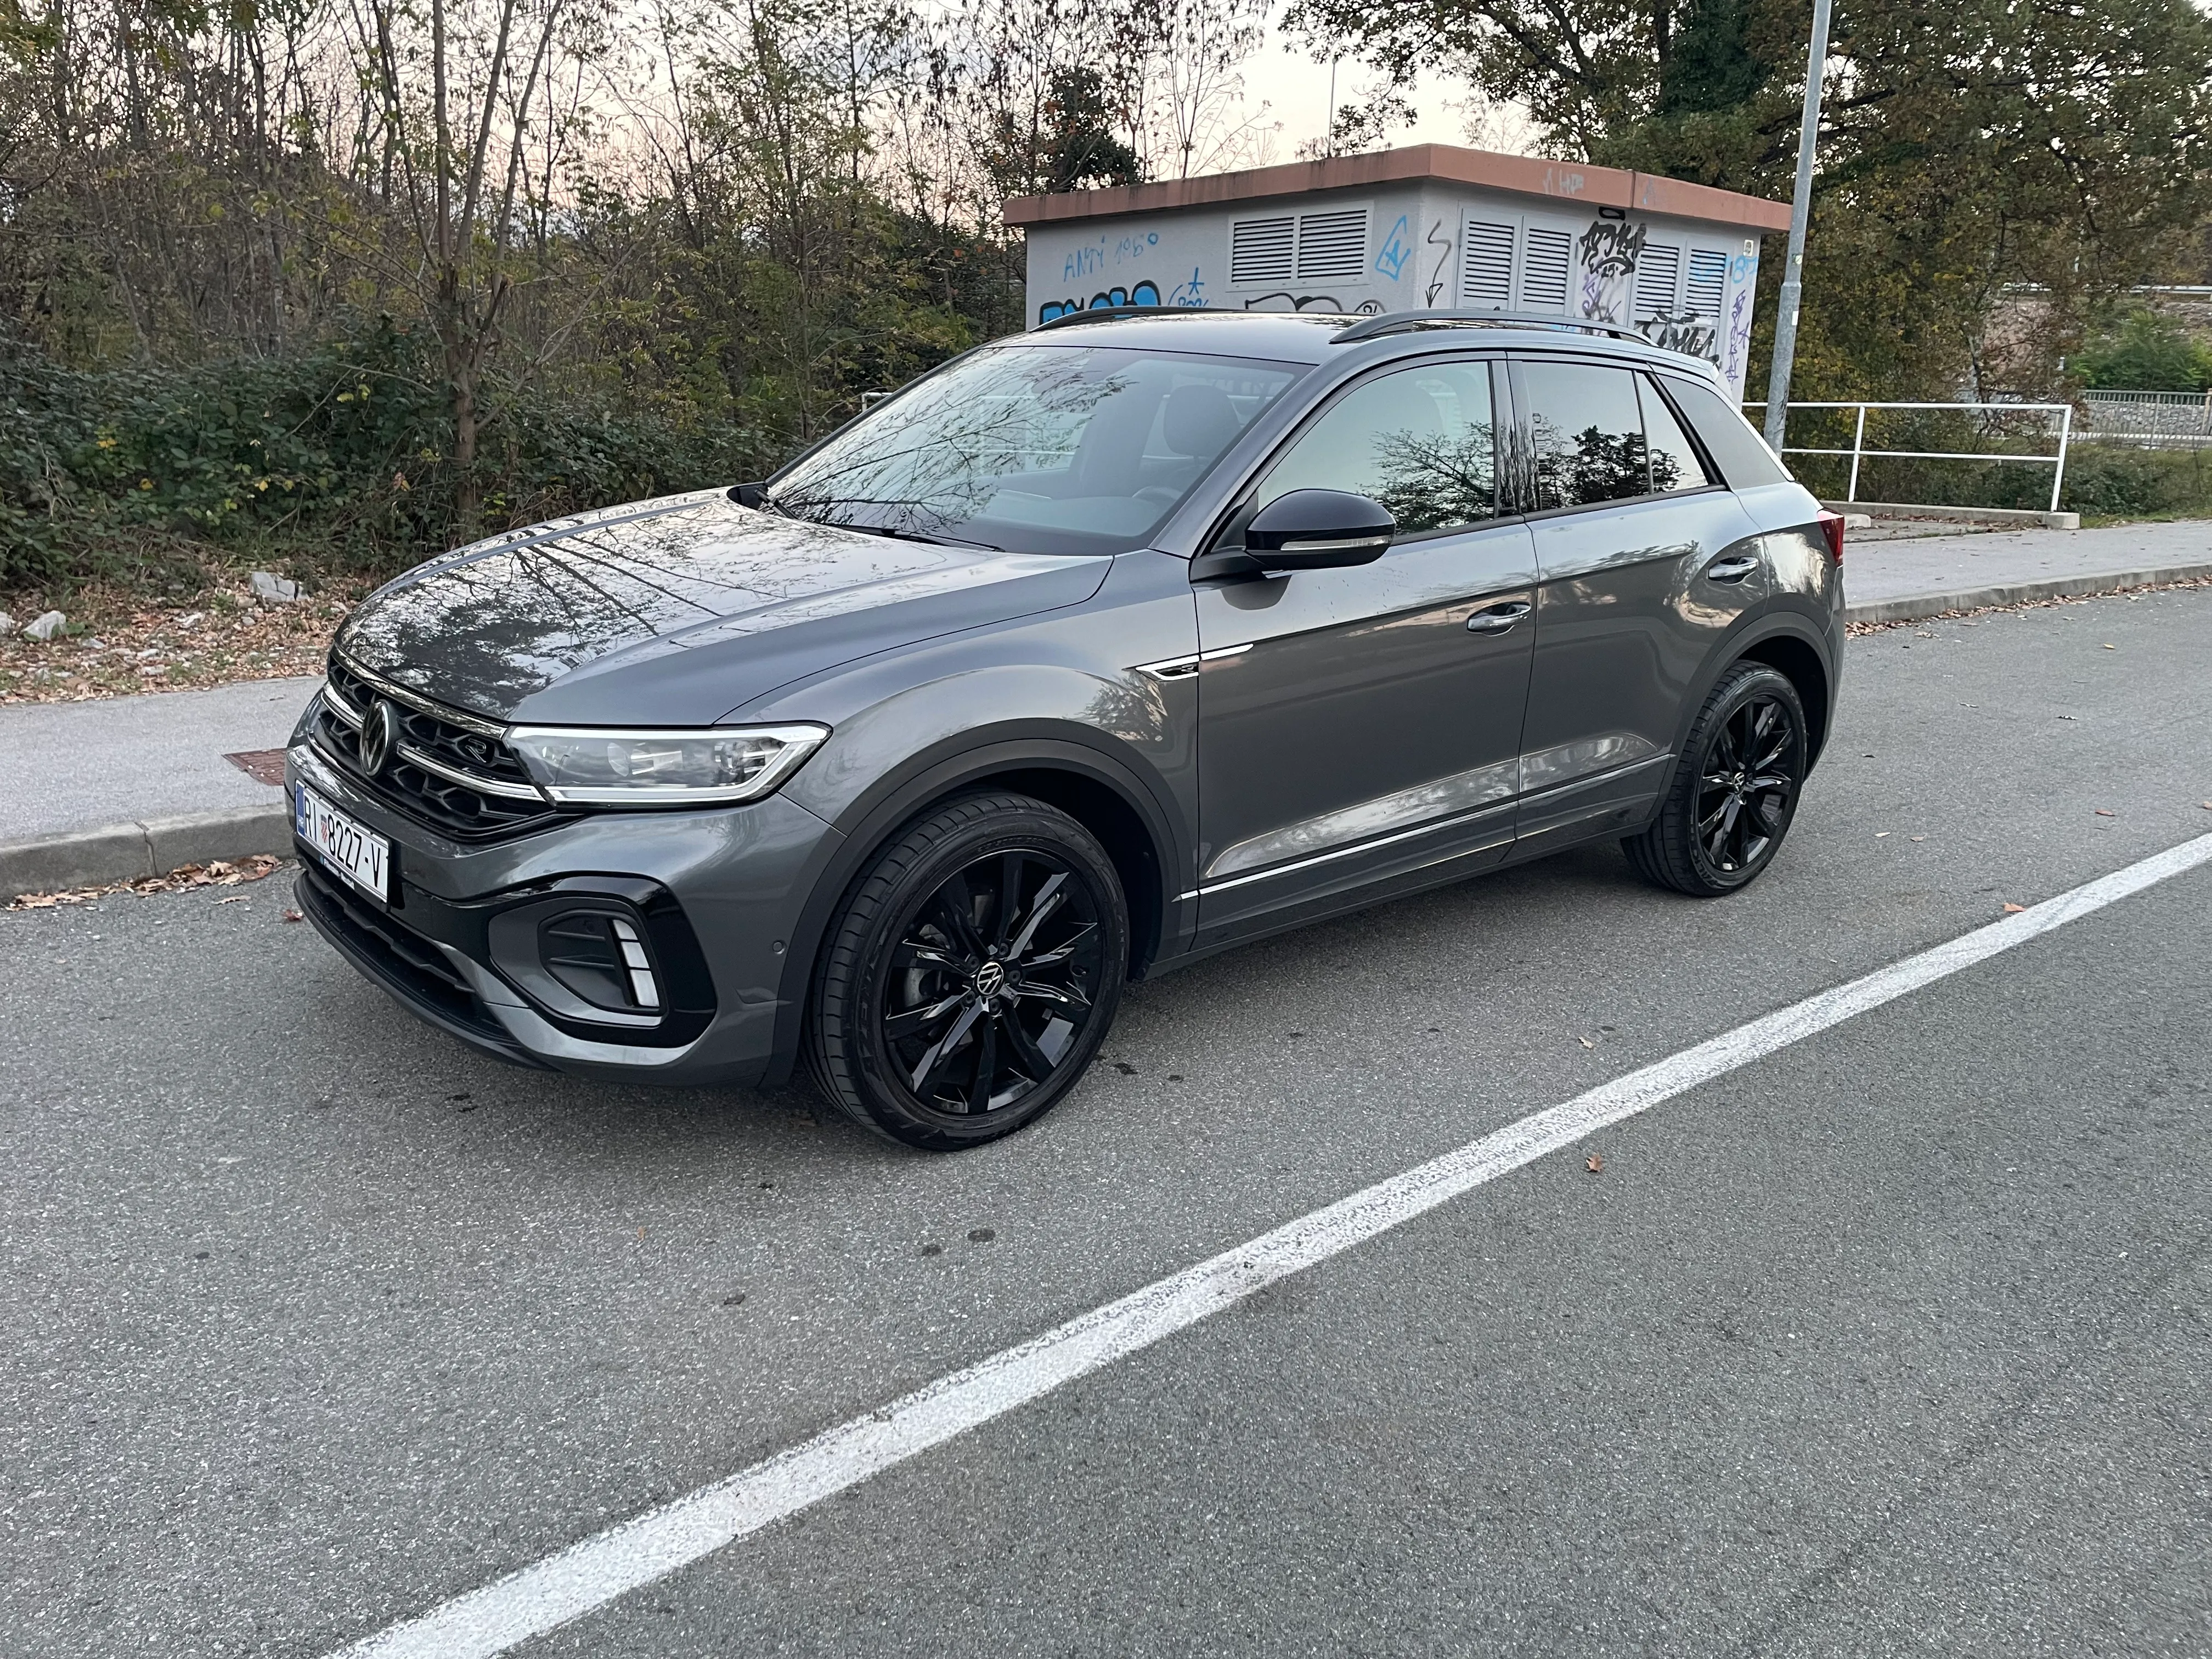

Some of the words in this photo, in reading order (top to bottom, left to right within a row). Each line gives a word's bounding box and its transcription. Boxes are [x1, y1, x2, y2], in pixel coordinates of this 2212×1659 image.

[465, 738, 487, 763] R
[304, 795, 318, 843] RI
[328, 814, 381, 888] 8227-V
